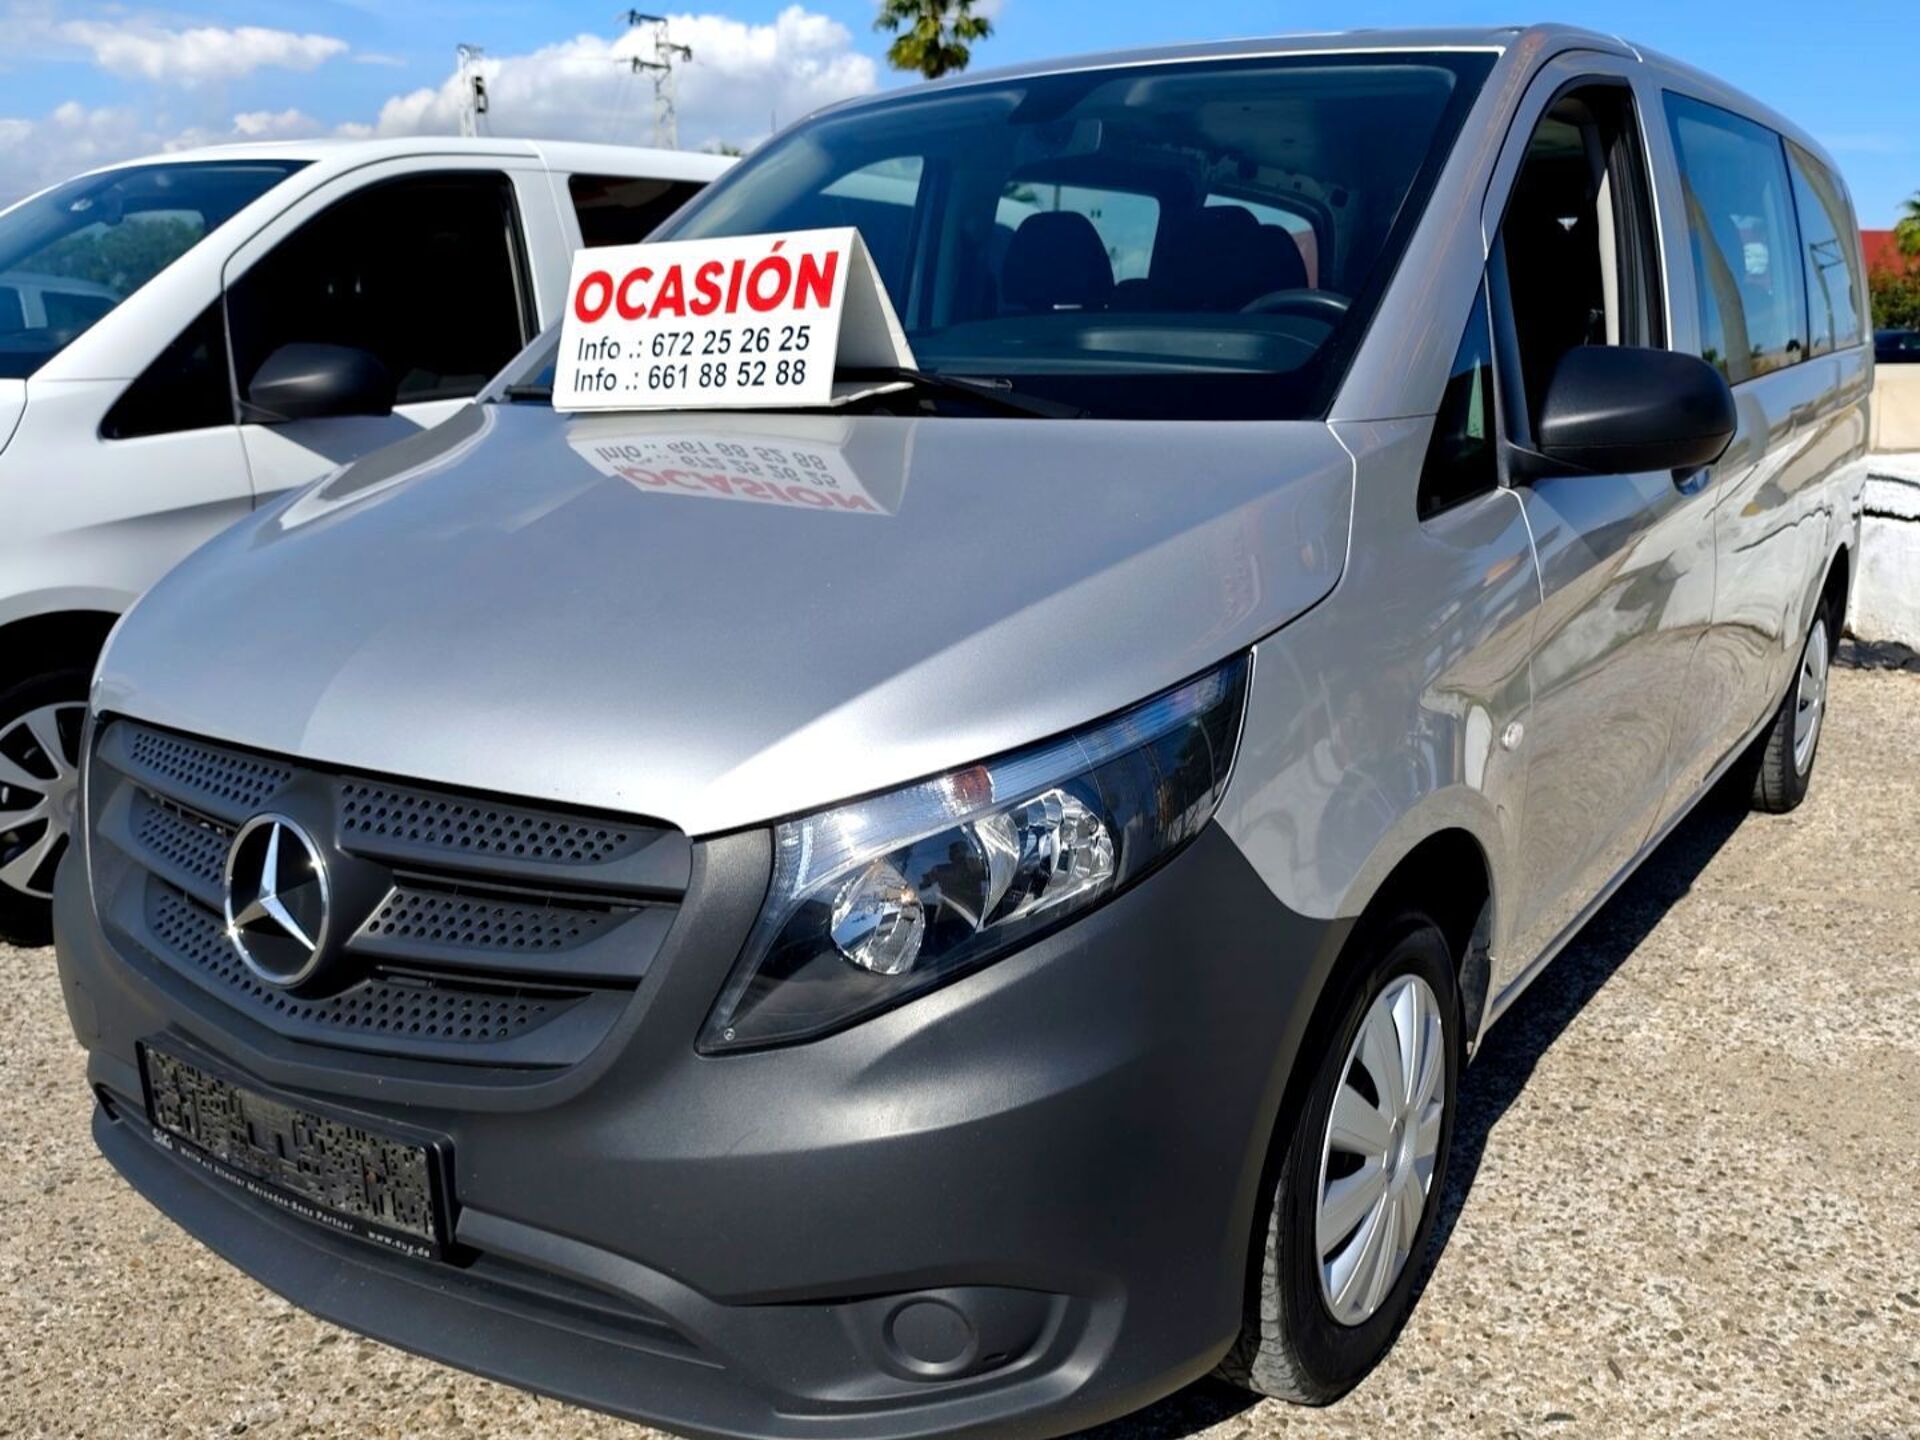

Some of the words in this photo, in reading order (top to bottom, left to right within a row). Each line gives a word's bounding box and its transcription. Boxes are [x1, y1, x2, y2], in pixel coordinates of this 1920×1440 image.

[574, 240, 839, 323] OCASIÓN
[577, 335, 621, 361] Info
[652, 331, 694, 358] 672
[701, 329, 732, 355] 25
[740, 326, 770, 353] 26
[778, 325, 811, 352] 25
[574, 366, 617, 392] Info
[648, 363, 689, 390] 661
[699, 362, 727, 388] 88
[737, 360, 766, 387] 52
[775, 359, 806, 386] 88
